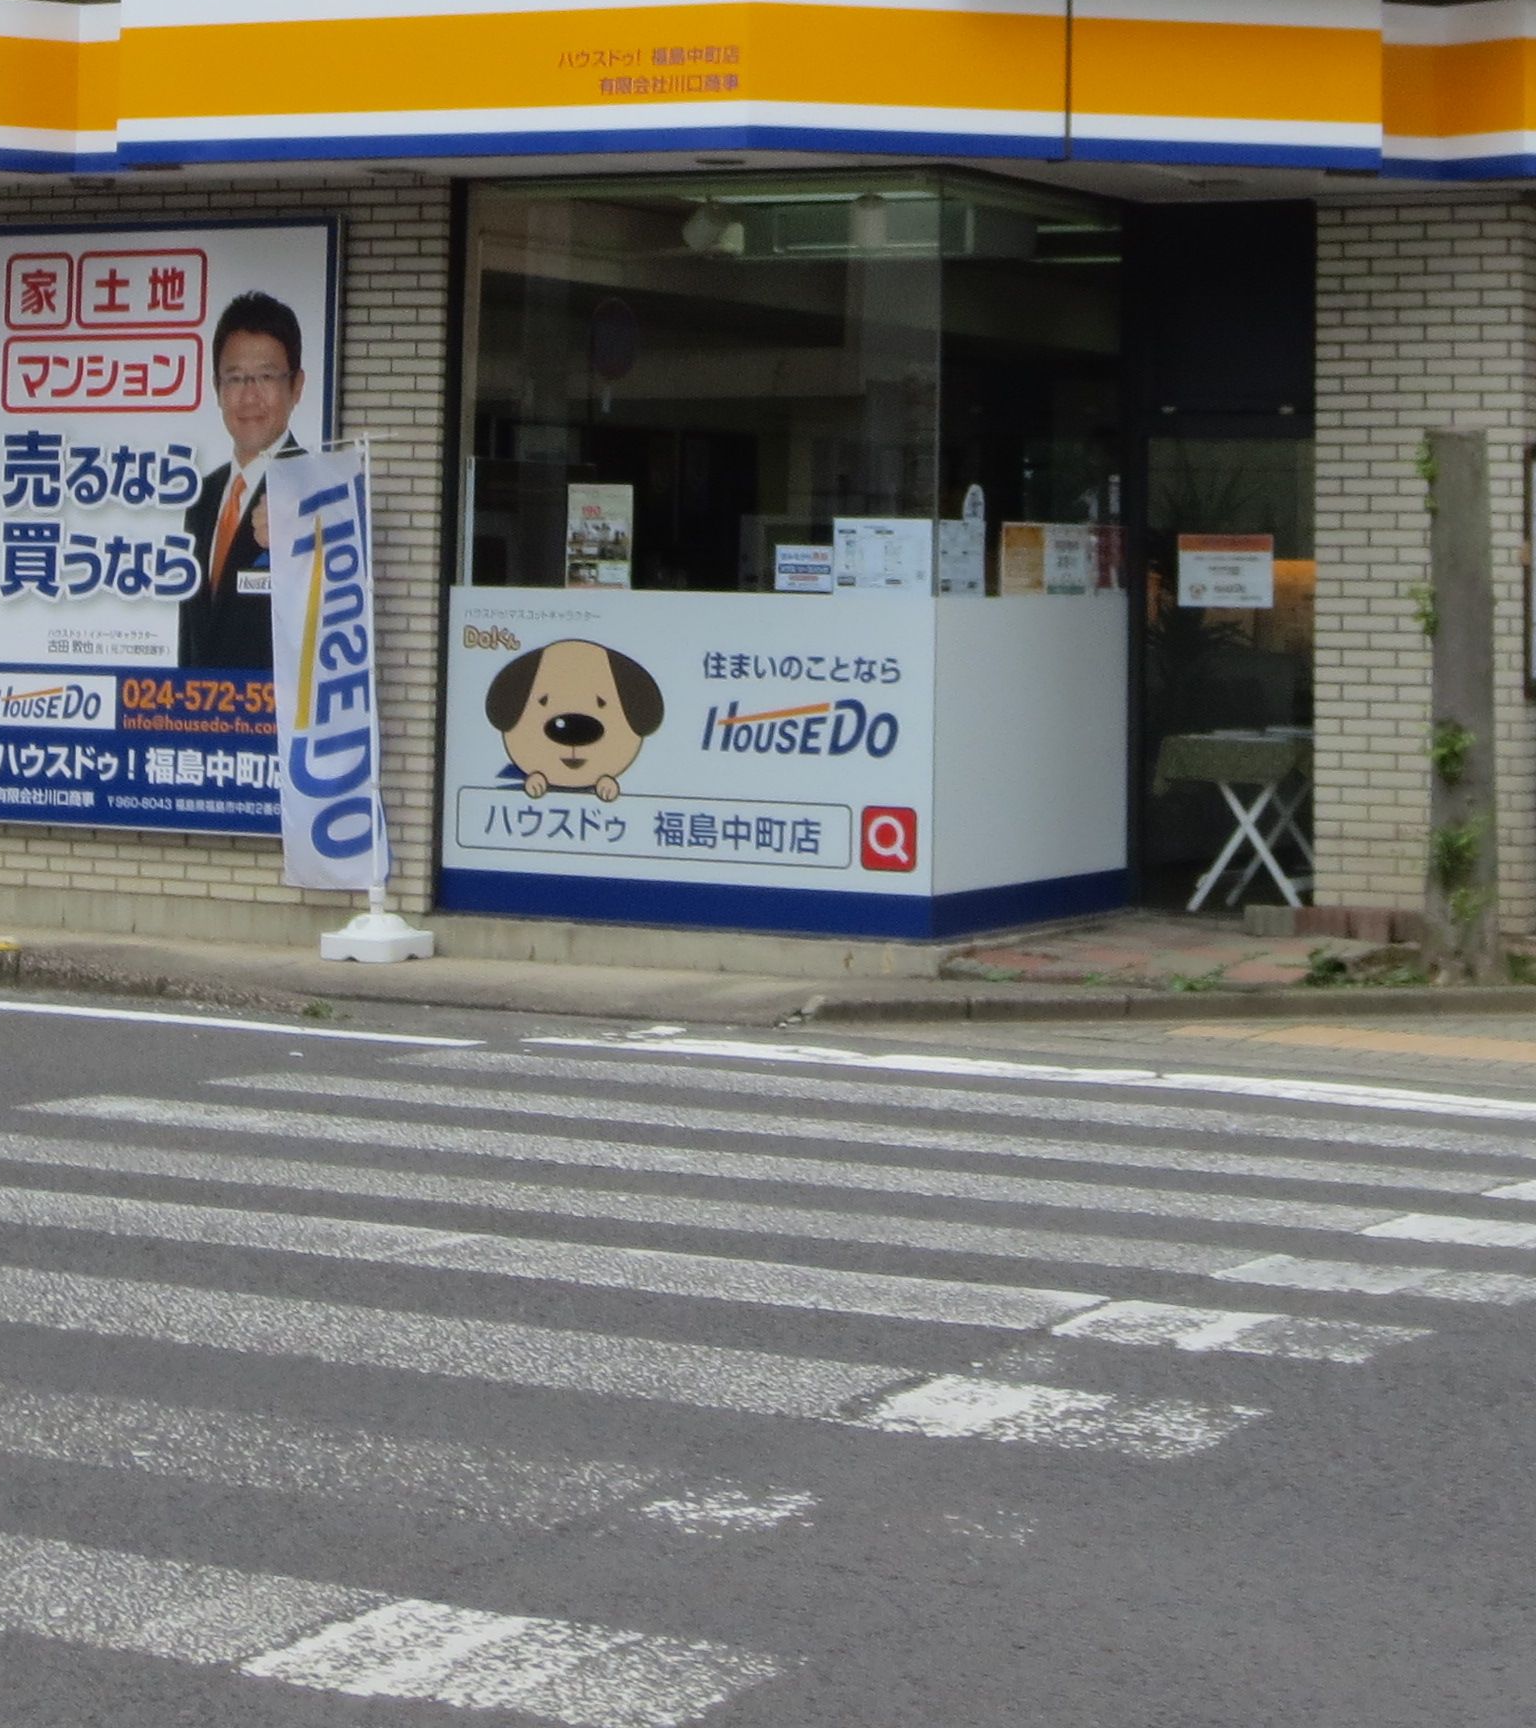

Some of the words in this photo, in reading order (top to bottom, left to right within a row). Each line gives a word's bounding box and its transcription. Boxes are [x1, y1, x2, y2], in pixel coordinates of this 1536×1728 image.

[21, 270, 57, 315] 家
[93, 267, 185, 313] 土地
[17, 354, 185, 398] マンション
[3, 430, 198, 508] 売るなら
[0, 523, 197, 597] 買うなら
[703, 652, 901, 685] 住まいのことなら
[484, 804, 627, 843] ハウスドゥ
[654, 811, 822, 855] 福島中町店
